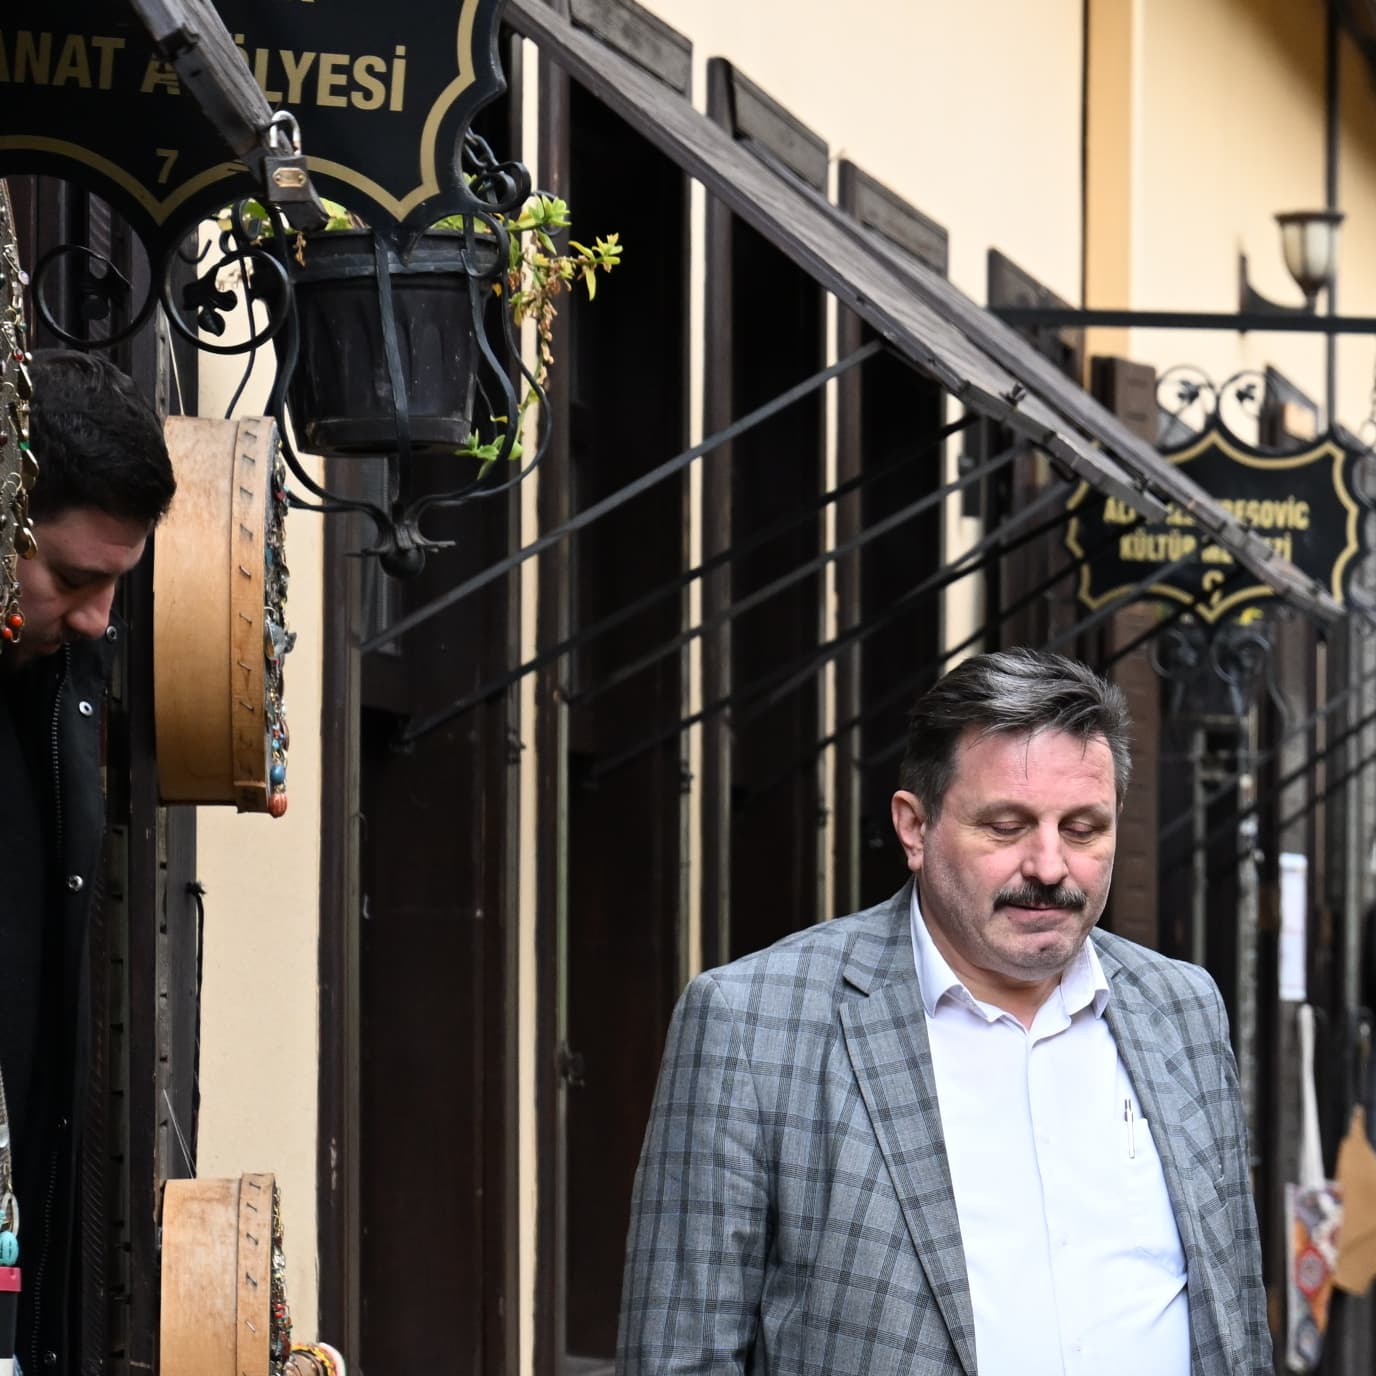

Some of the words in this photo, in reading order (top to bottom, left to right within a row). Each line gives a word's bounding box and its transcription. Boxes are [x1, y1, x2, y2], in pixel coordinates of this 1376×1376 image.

[141, 34, 409, 113] ALYESİ
[155, 148, 180, 184] 7
[1119, 526, 1198, 562] KÜLTÜR
